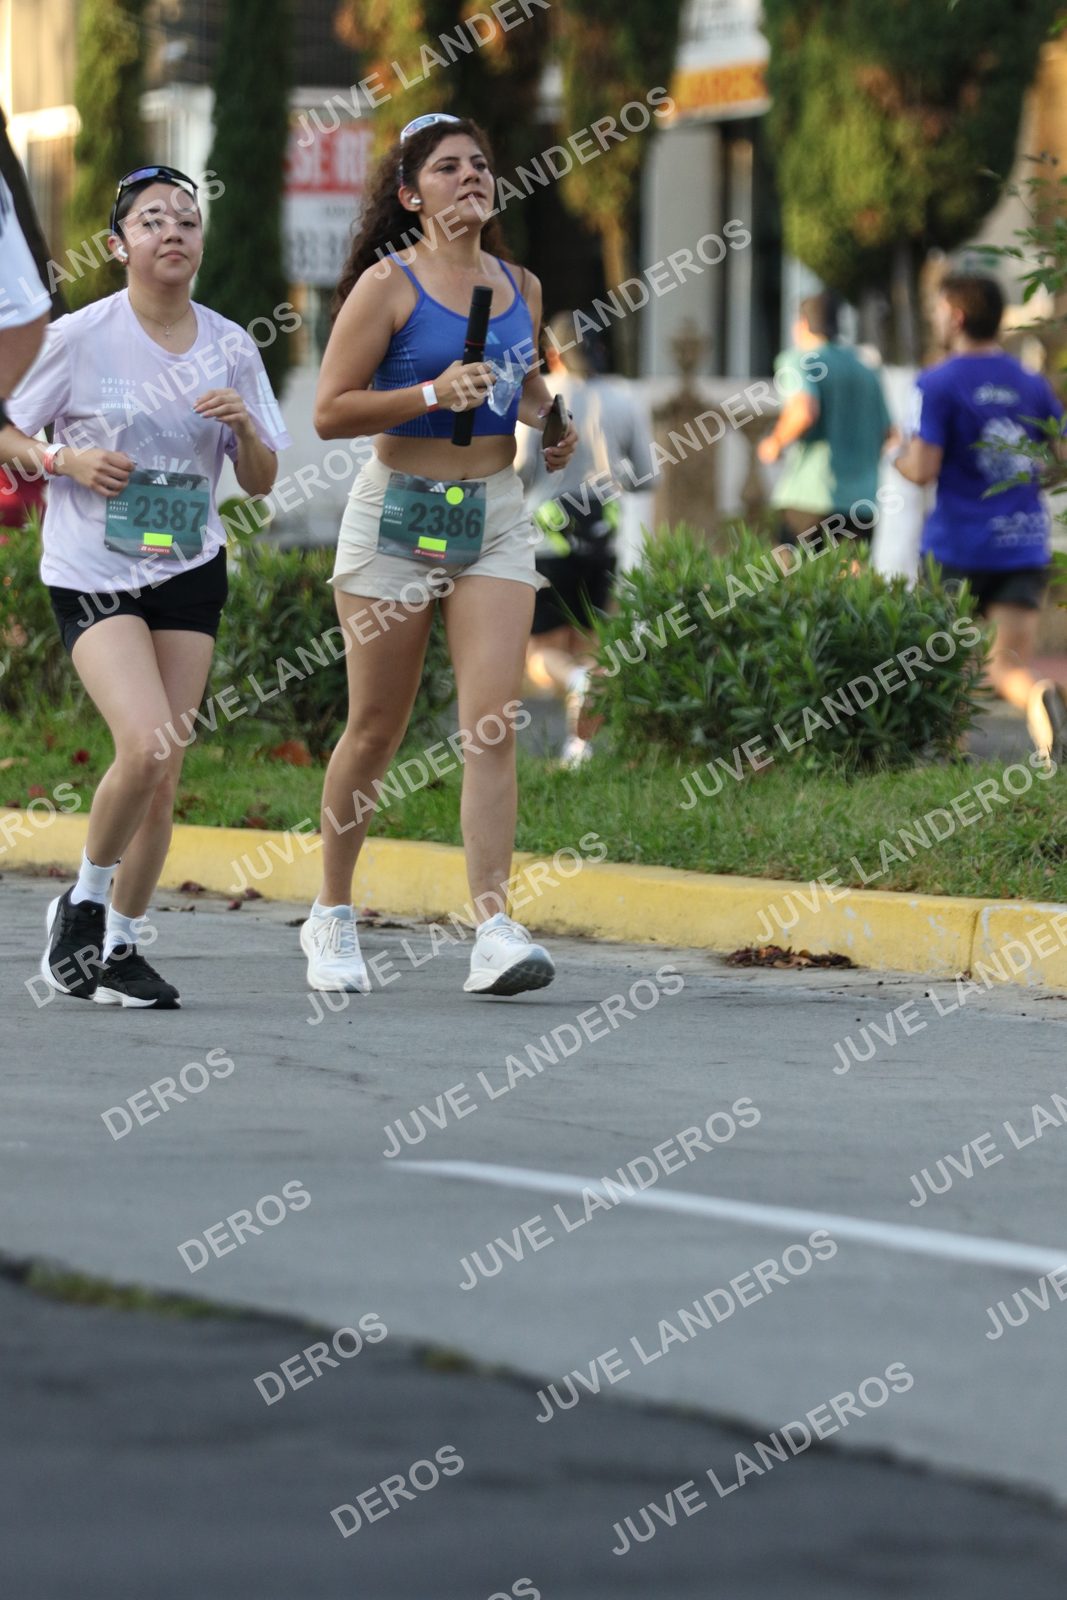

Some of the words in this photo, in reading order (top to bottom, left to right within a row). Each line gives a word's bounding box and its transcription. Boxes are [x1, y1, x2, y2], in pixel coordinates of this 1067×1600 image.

[101, 377, 136, 386] ADIDAS
[132, 495, 205, 533] 2387
[407, 502, 482, 538] 2386
